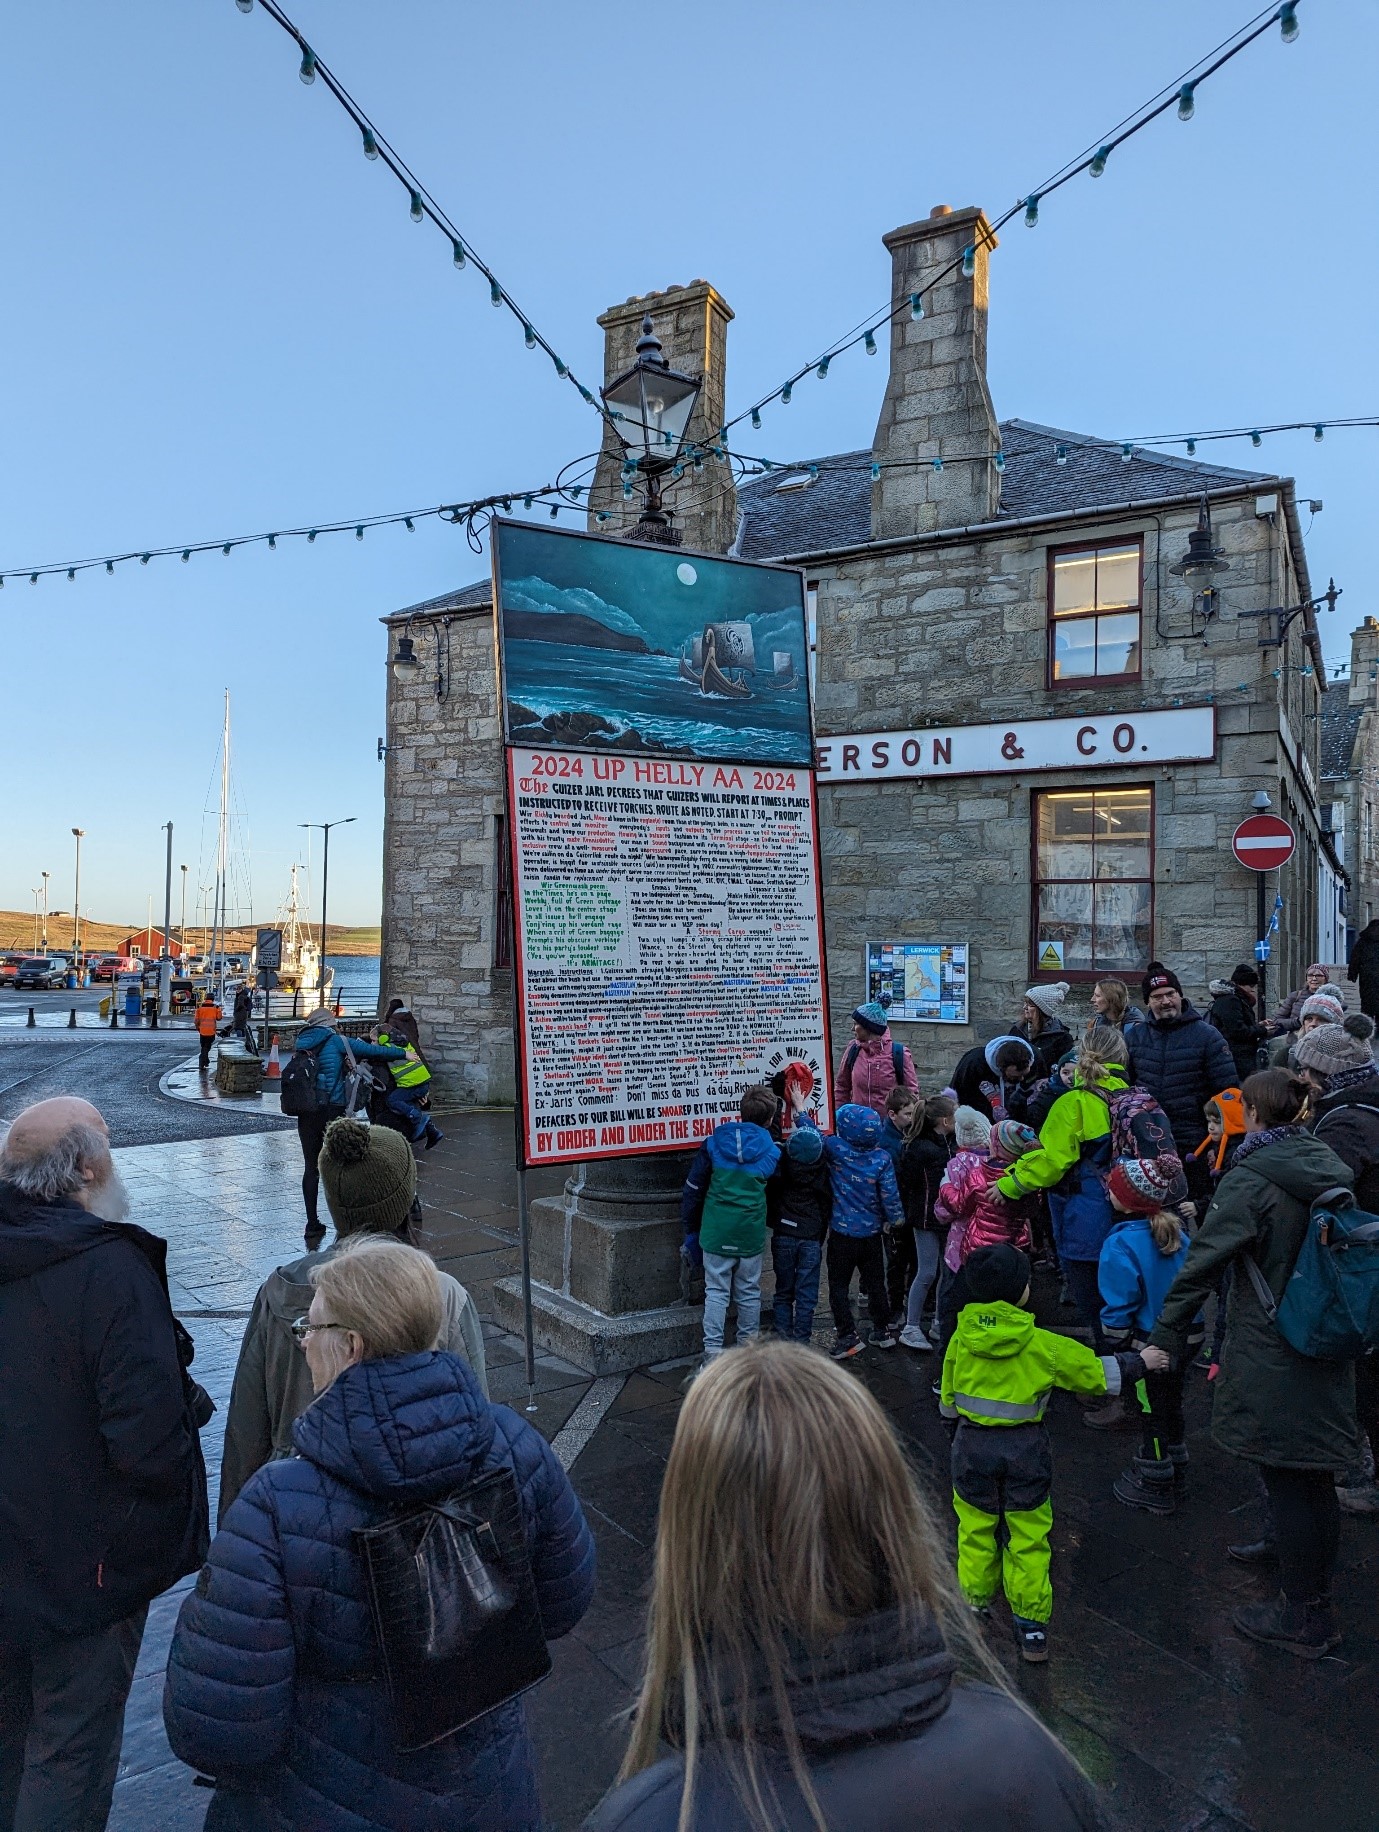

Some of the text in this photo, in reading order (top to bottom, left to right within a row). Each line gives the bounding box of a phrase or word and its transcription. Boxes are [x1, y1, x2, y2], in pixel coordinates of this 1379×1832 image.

[1001, 732, 1024, 760] &
[1076, 722, 1148, 755] CO.
[532, 755, 796, 791] 2024 UP HELLY AA 2024
[519, 778, 548, 795] The
[552, 783, 583, 795] GUIZER
[585, 785, 605, 797] JARL
[607, 787, 642, 799] DECREES
[642, 789, 664, 800] THAT
[666, 790, 700, 802] GUIZERS
[701, 793, 721, 803] WILL
[722, 794, 750, 805] REPORT
[761, 796, 782, 807] TIMES
[788, 797, 810, 808] PLACES
[519, 797, 572, 810] INSTRUCTED
[584, 800, 618, 813] RECEIVE
[620, 802, 656, 815] TORCHES.
[656, 805, 679, 816] ROUTE
[717, 808, 739, 818] START
[768, 1052, 784, 1068] FOR
[786, 1046, 808, 1060] WHAT
[808, 1058, 820, 1073] WE
[627, 1091, 646, 1102] Don't
[651, 1089, 669, 1100] miss
[535, 1114, 576, 1128] DEFACERS
[578, 1113, 588, 1125] OF
[590, 1111, 608, 1124] OUR
[610, 1110, 625, 1122] BILL
[626, 1108, 644, 1120] WILL
[646, 1107, 656, 1119] BE
[694, 1103, 703, 1115] BY
[704, 1102, 718, 1114] THE
[537, 1132, 553, 1152] BY
[557, 1128, 596, 1150] ORDER
[601, 1126, 625, 1146] AND
[629, 1122, 666, 1143] UNDER
[669, 1120, 689, 1139] THE
